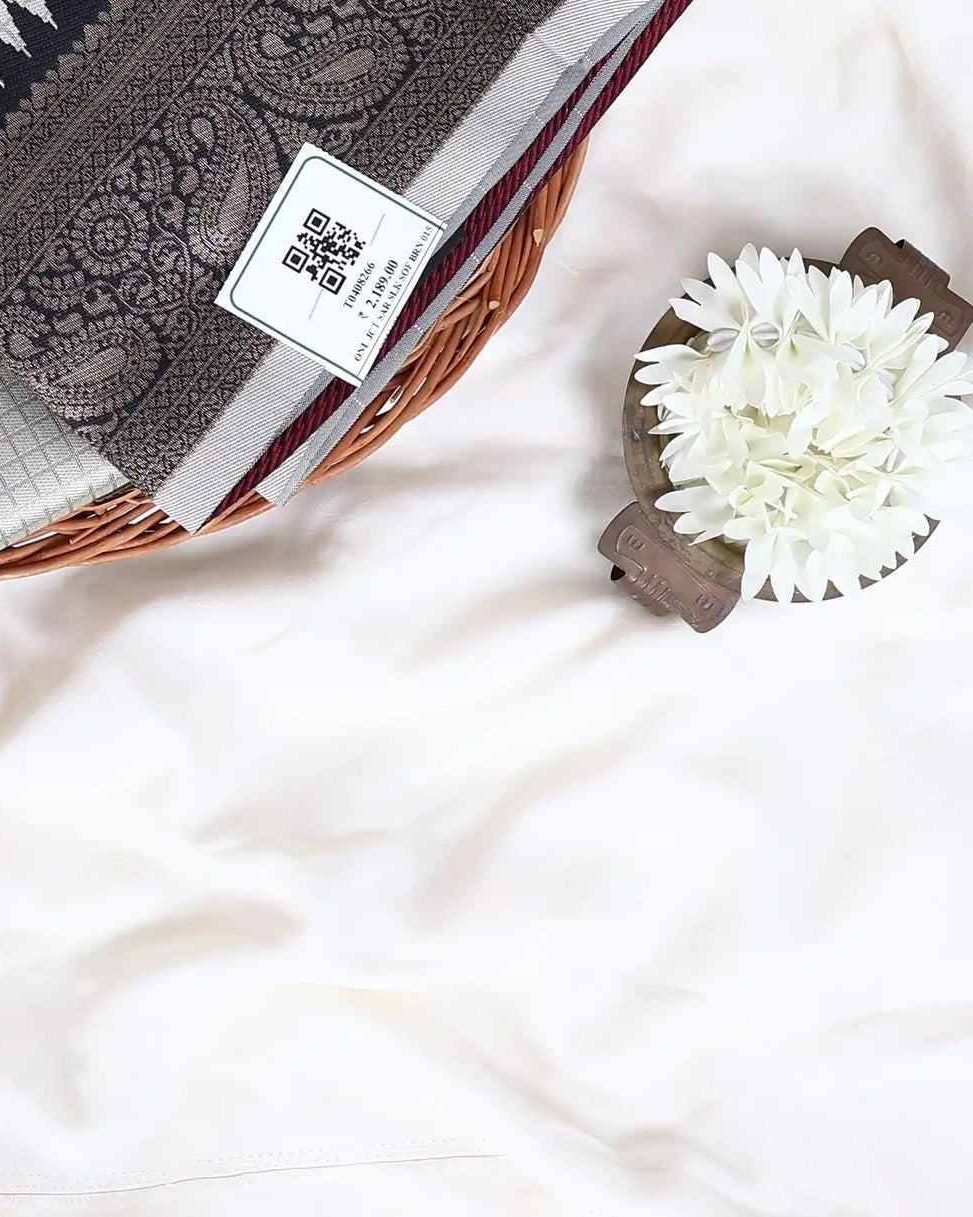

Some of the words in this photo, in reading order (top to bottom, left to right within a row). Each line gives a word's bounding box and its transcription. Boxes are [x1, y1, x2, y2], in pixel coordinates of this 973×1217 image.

[342, 261, 375, 308] T0408266
[377, 301, 391, 321] SAR
[387, 280, 402, 301] SLK
[398, 261, 411, 281] SOF
[408, 241, 423, 262] BRN
[420, 225, 432, 241] 015
